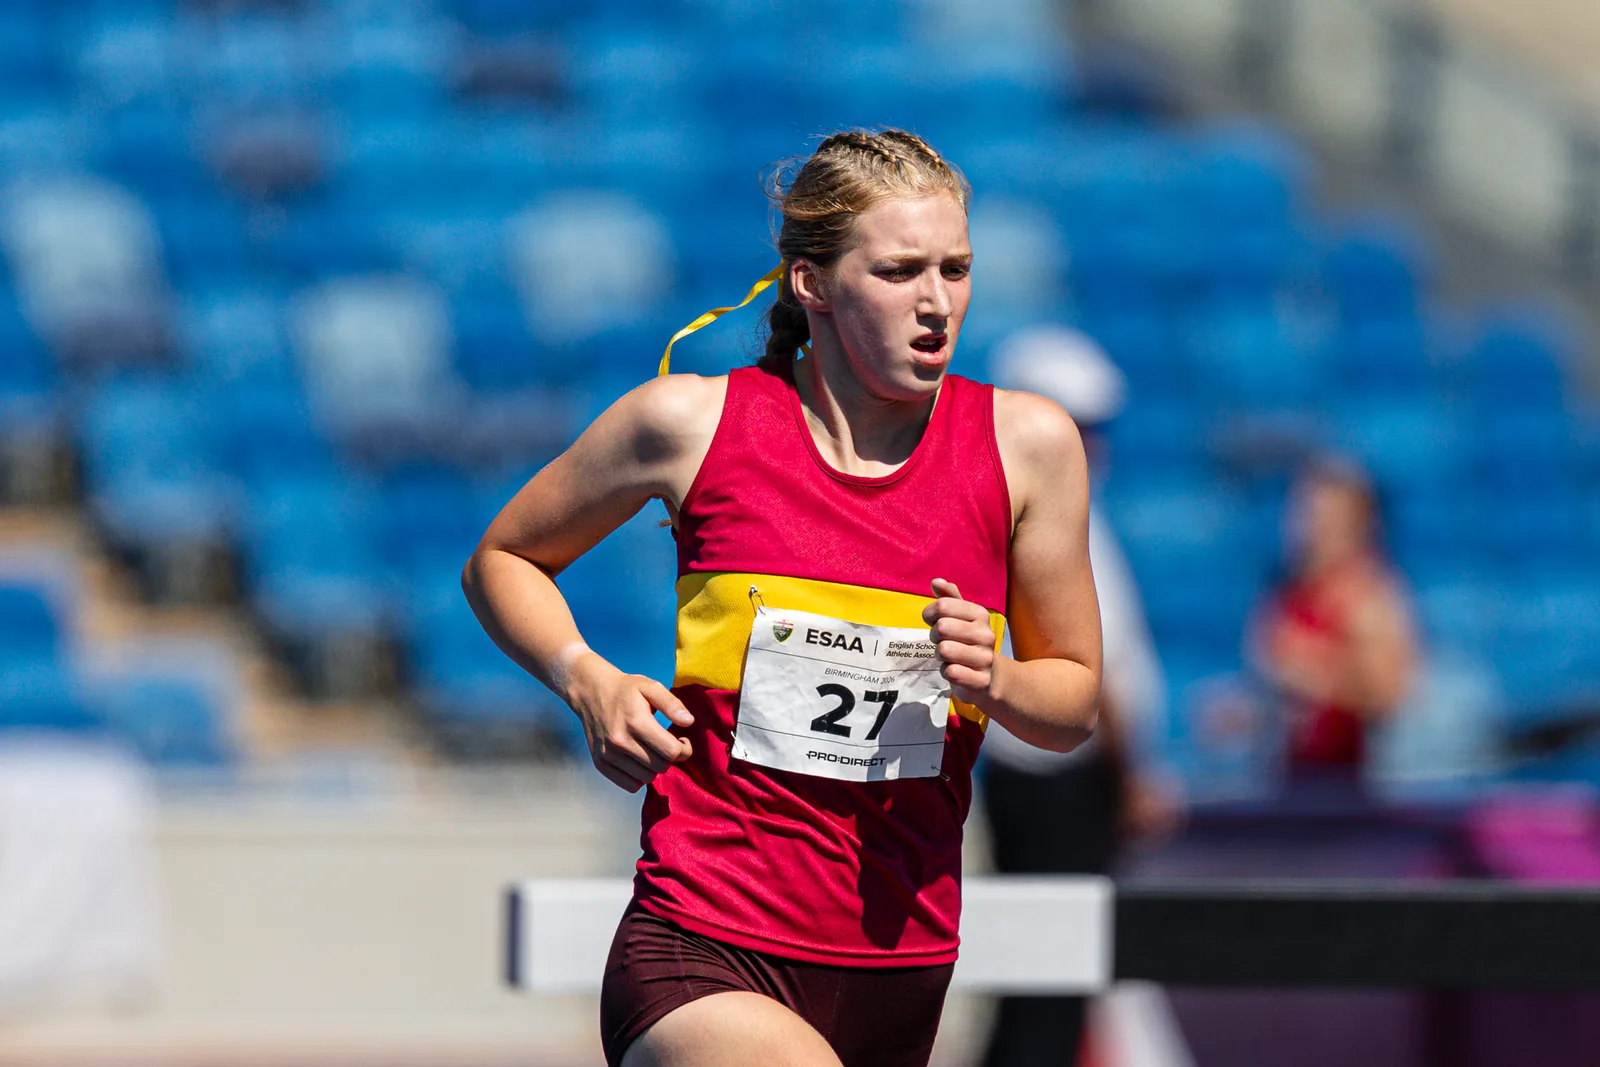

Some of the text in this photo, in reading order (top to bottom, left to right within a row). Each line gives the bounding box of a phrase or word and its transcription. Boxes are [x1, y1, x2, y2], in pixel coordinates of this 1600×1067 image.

[806, 628, 864, 654] ESAA
[888, 642, 914, 650] English
[824, 667, 896, 685] BIRMINGHAM 2026
[810, 683, 899, 741] 27
[806, 750, 886, 767] PRO:DIRECT
